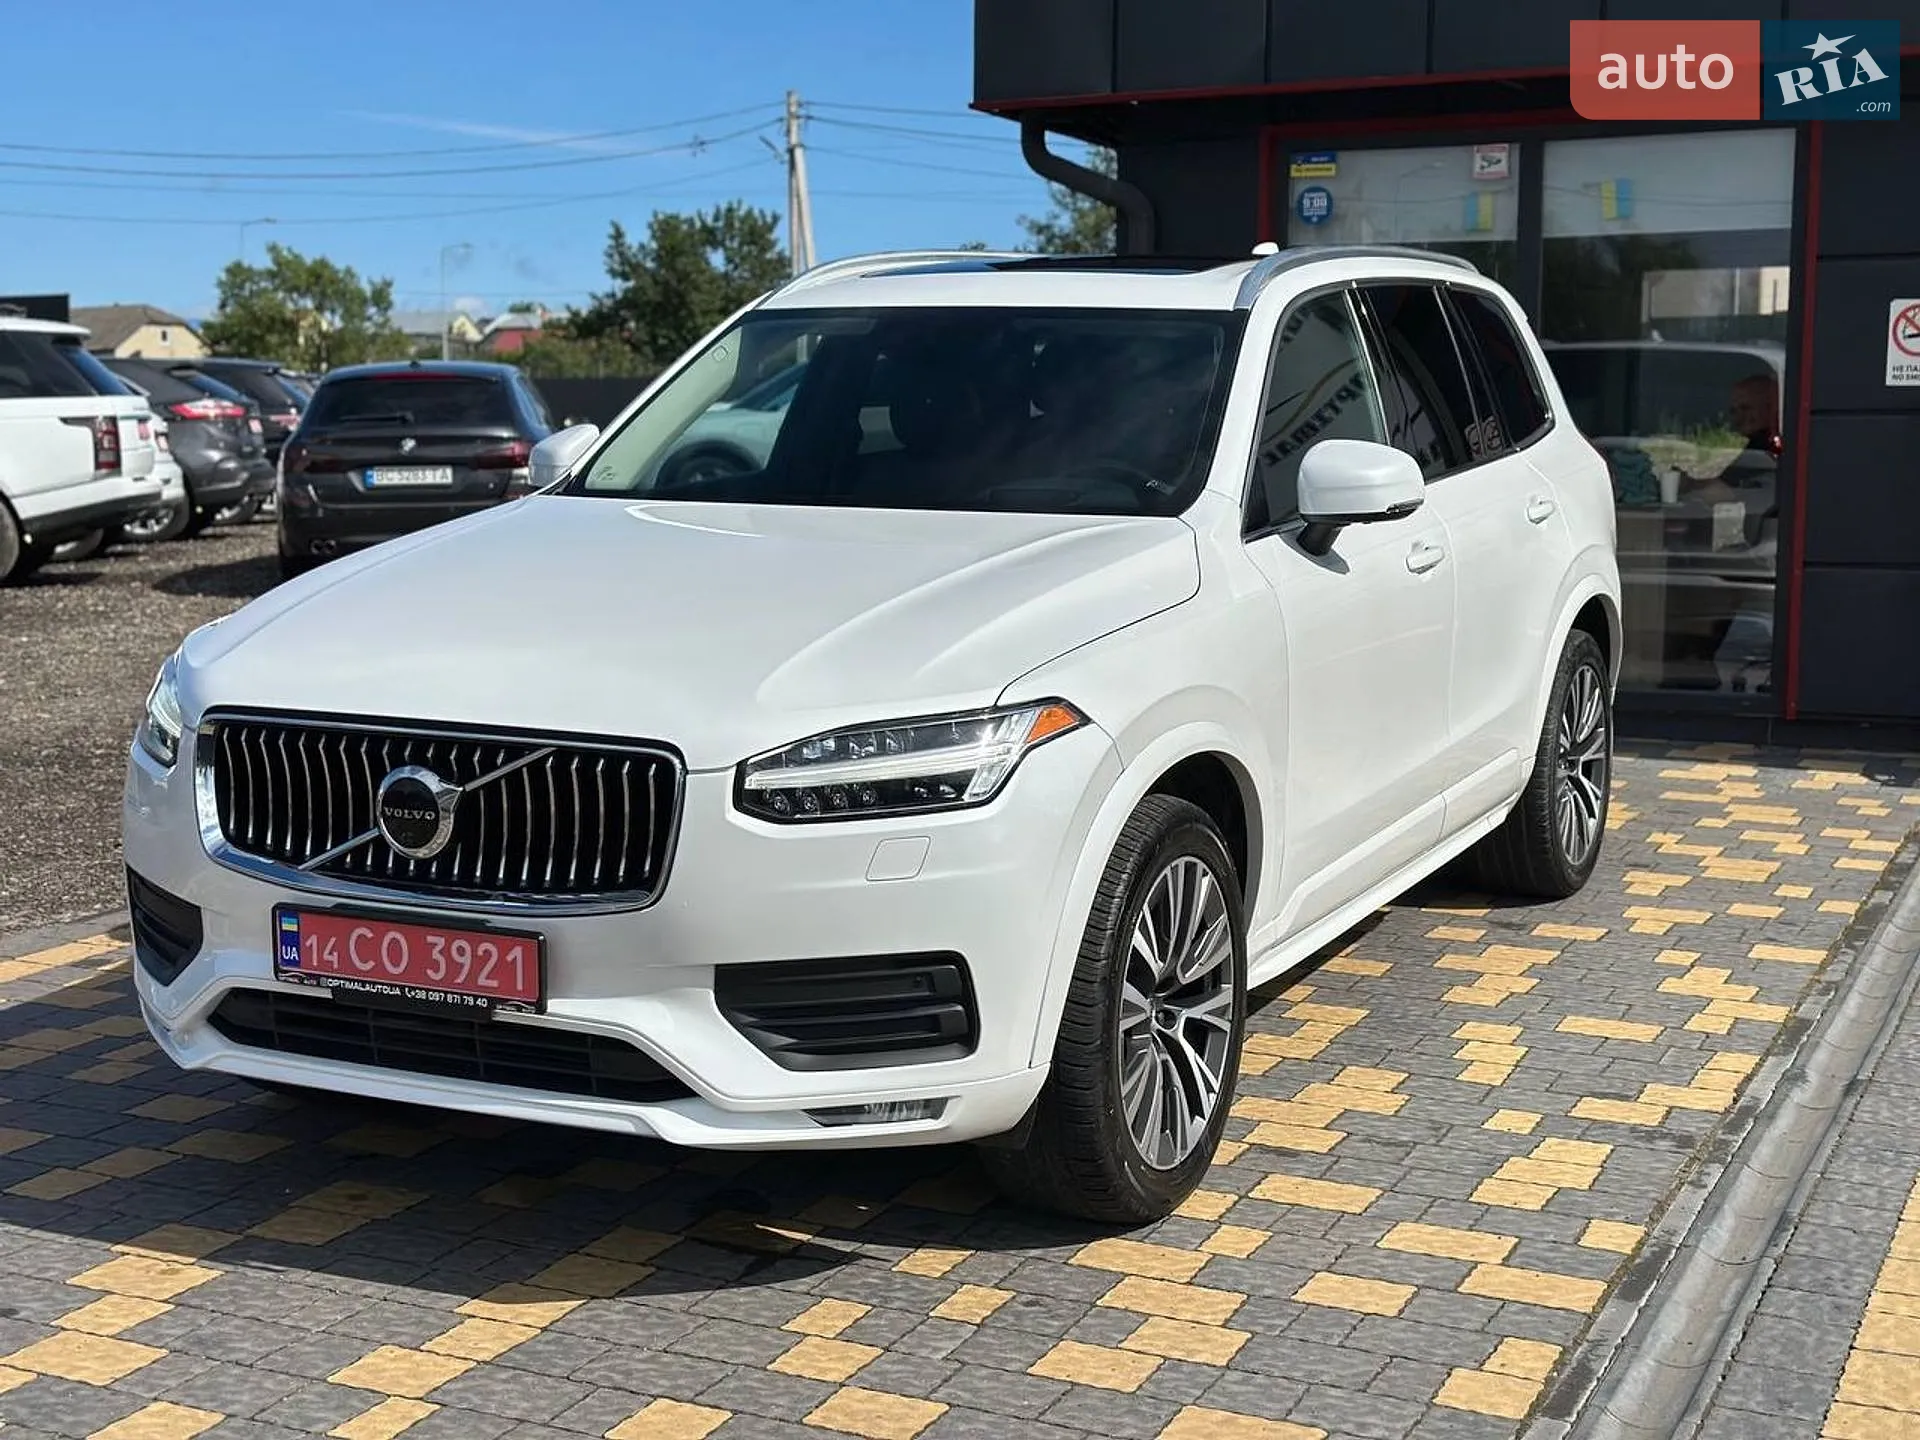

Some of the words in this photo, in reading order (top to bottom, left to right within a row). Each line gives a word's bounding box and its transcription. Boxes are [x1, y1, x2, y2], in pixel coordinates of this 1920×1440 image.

[1906, 364, 1920, 373] ПА
[383, 806, 435, 820] VOLVO
[282, 946, 299, 960] UA
[305, 934, 339, 969] 14
[349, 927, 409, 974] CO
[426, 936, 524, 991] 3921
